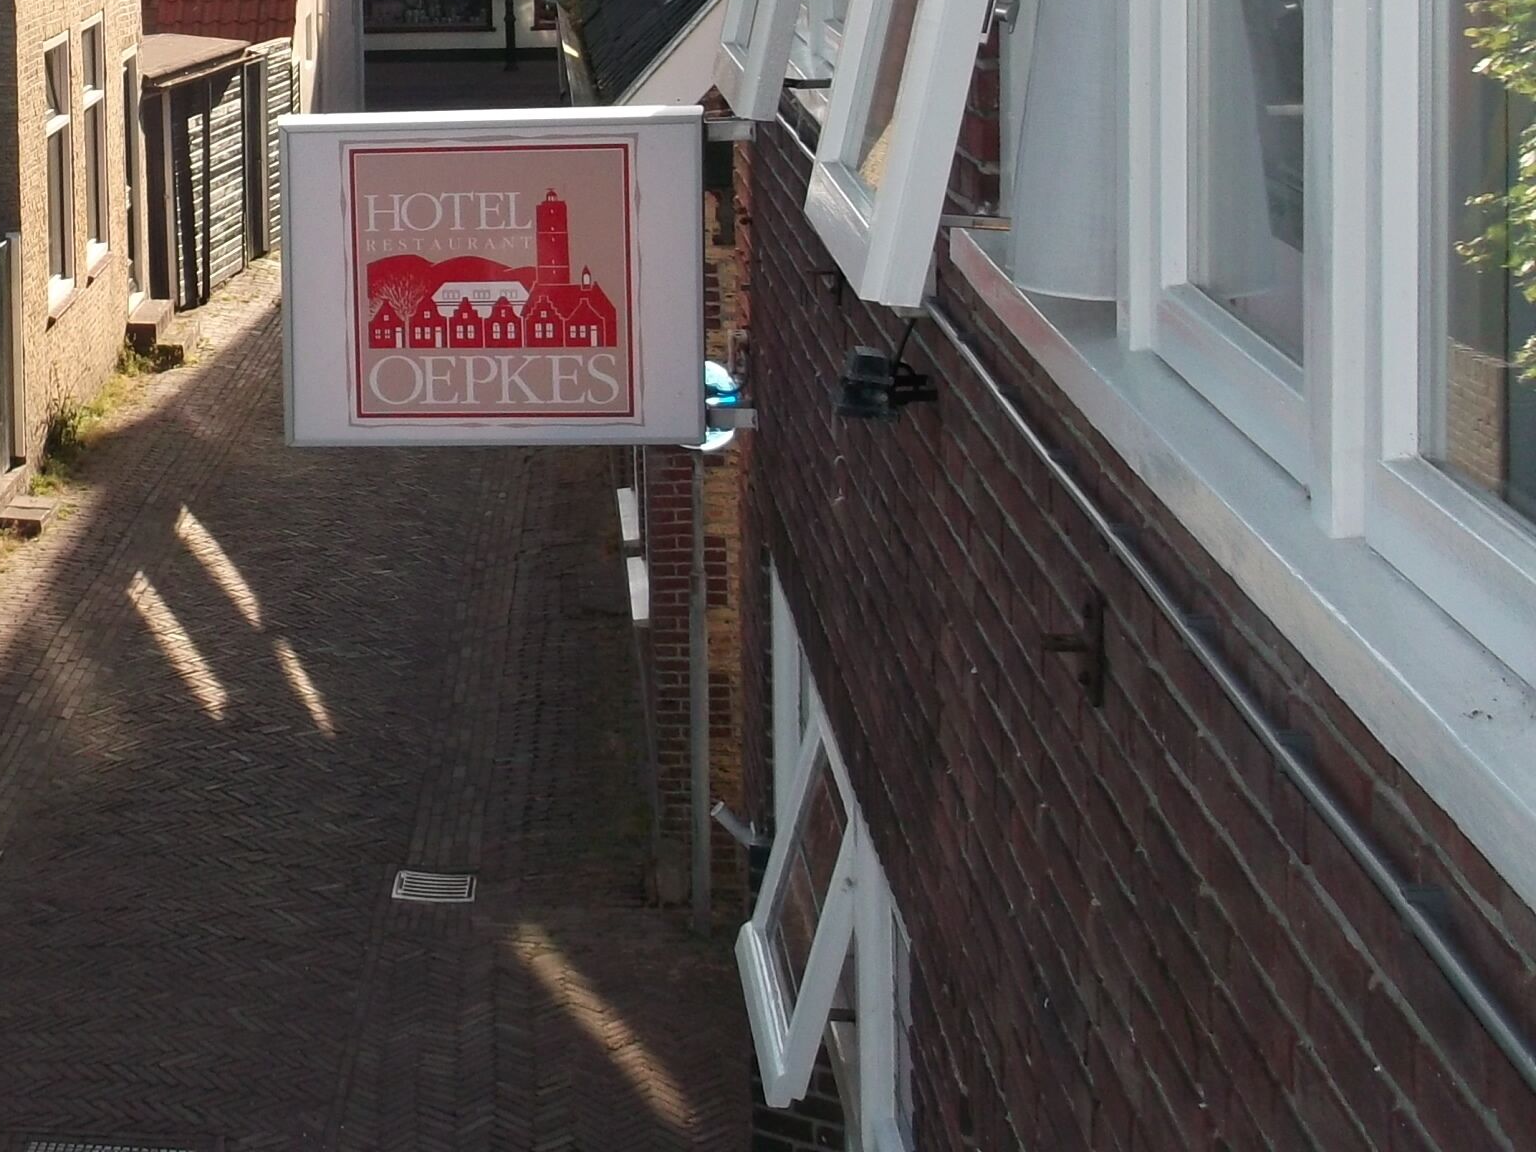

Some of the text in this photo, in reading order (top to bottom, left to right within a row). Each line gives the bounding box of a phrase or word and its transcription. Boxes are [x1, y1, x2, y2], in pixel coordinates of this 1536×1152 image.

[365, 192, 532, 231] HOTEL
[366, 236, 533, 252] RESTAURANT
[369, 353, 620, 405] OEPKES
